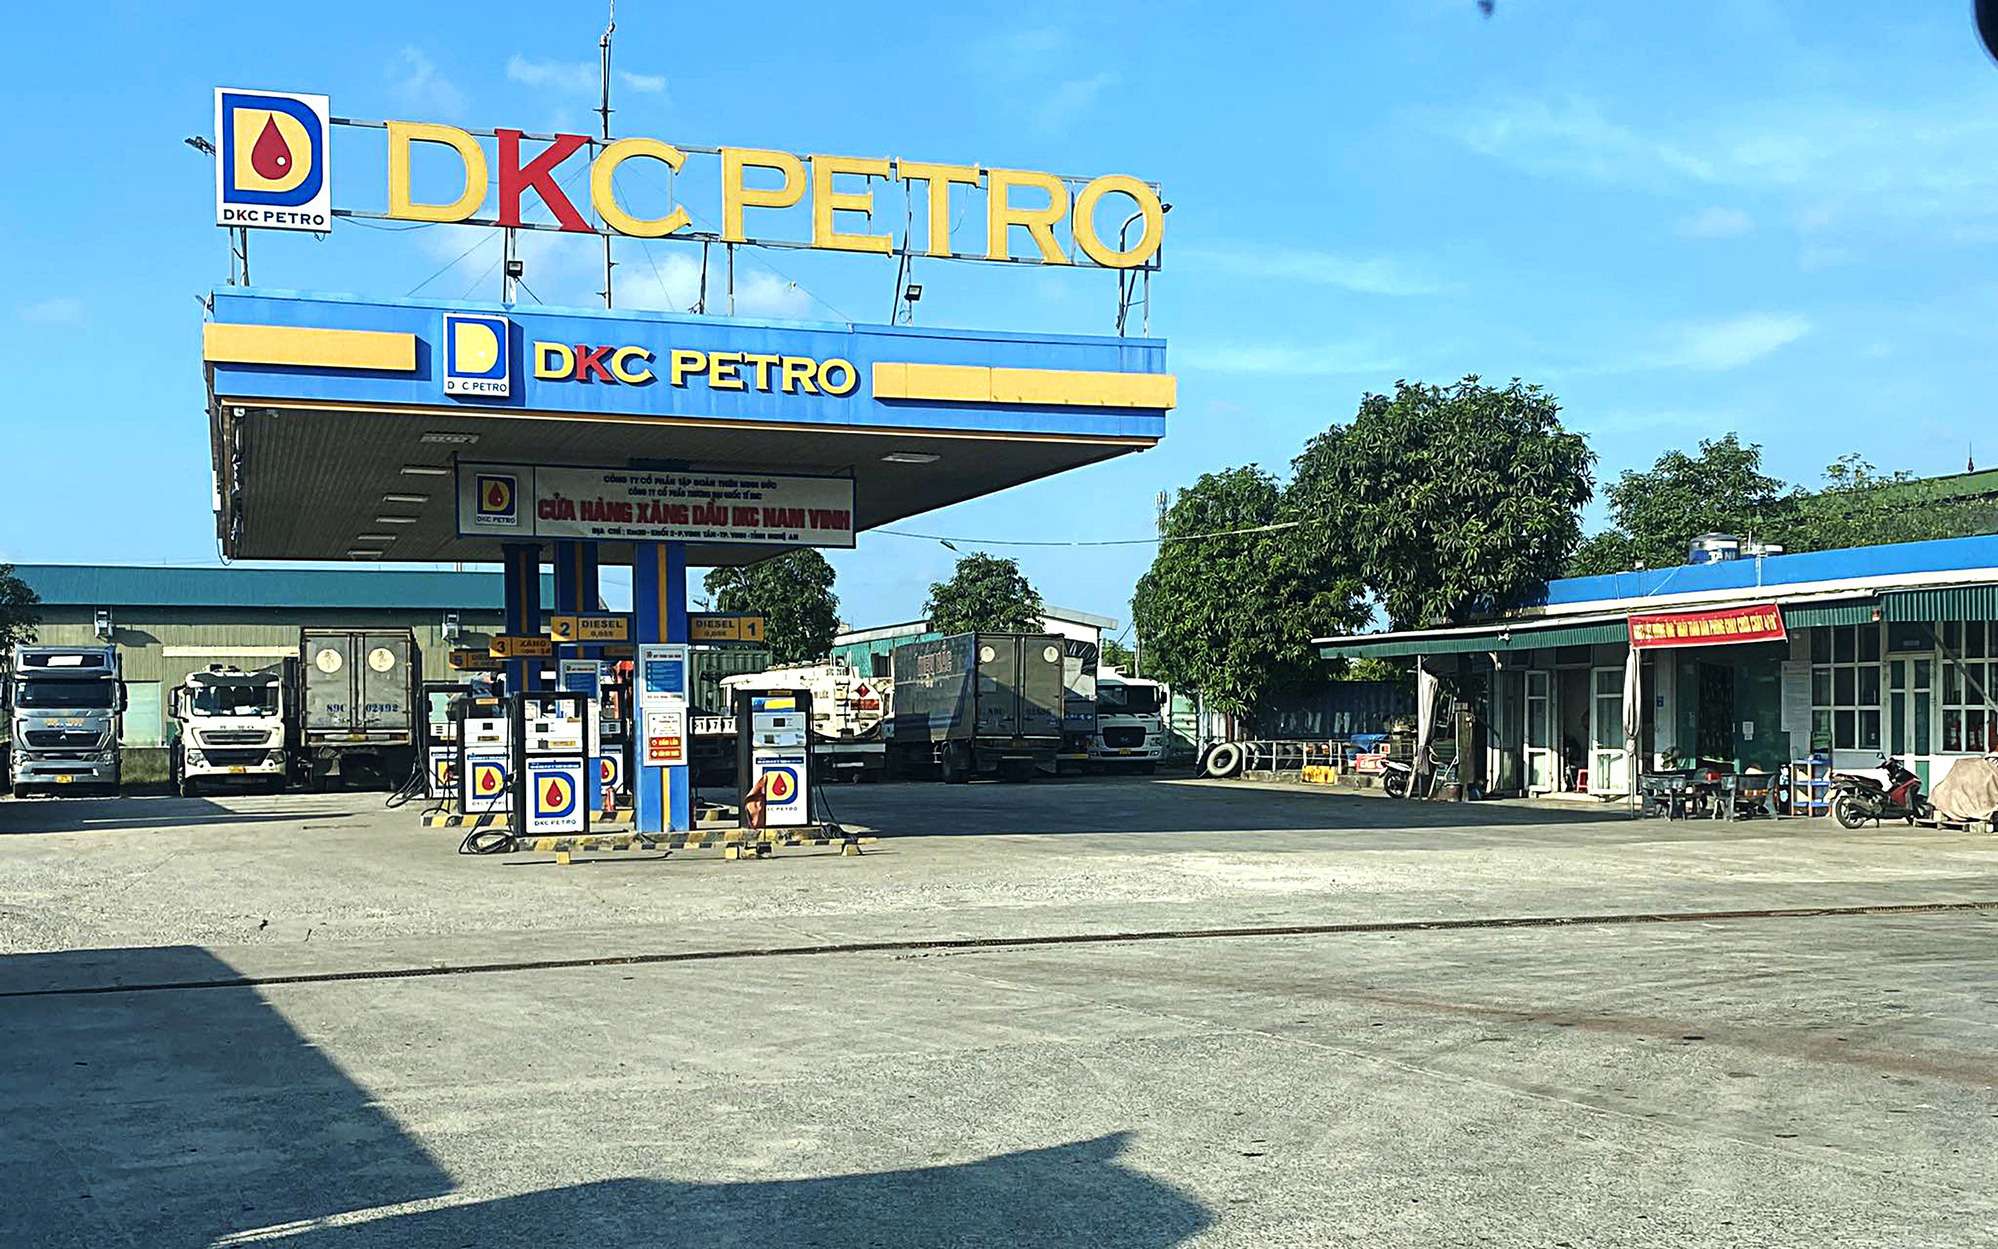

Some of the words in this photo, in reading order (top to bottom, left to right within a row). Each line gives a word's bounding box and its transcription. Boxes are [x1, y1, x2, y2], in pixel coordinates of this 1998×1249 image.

[384, 120, 691, 238] DKC
[718, 146, 1164, 269] PETRO
[223, 208, 259, 222] DKC
[264, 211, 325, 225] PETRO
[532, 341, 655, 383] DKC
[669, 348, 857, 395] PETRO
[472, 382, 508, 392] PETRO
[538, 492, 577, 521] CỬA
[580, 496, 633, 523] HÀNG
[636, 499, 689, 525] XĂNG
[692, 498, 729, 527] DẦU
[732, 505, 759, 527] DKC
[762, 507, 806, 529] NAM
[808, 508, 851, 530] VINH
[559, 621, 571, 637] 2
[582, 620, 623, 628] DIESEL
[696, 619, 735, 628] DIESEL
[747, 621, 756, 636] 1
[496, 640, 506, 653] 3
